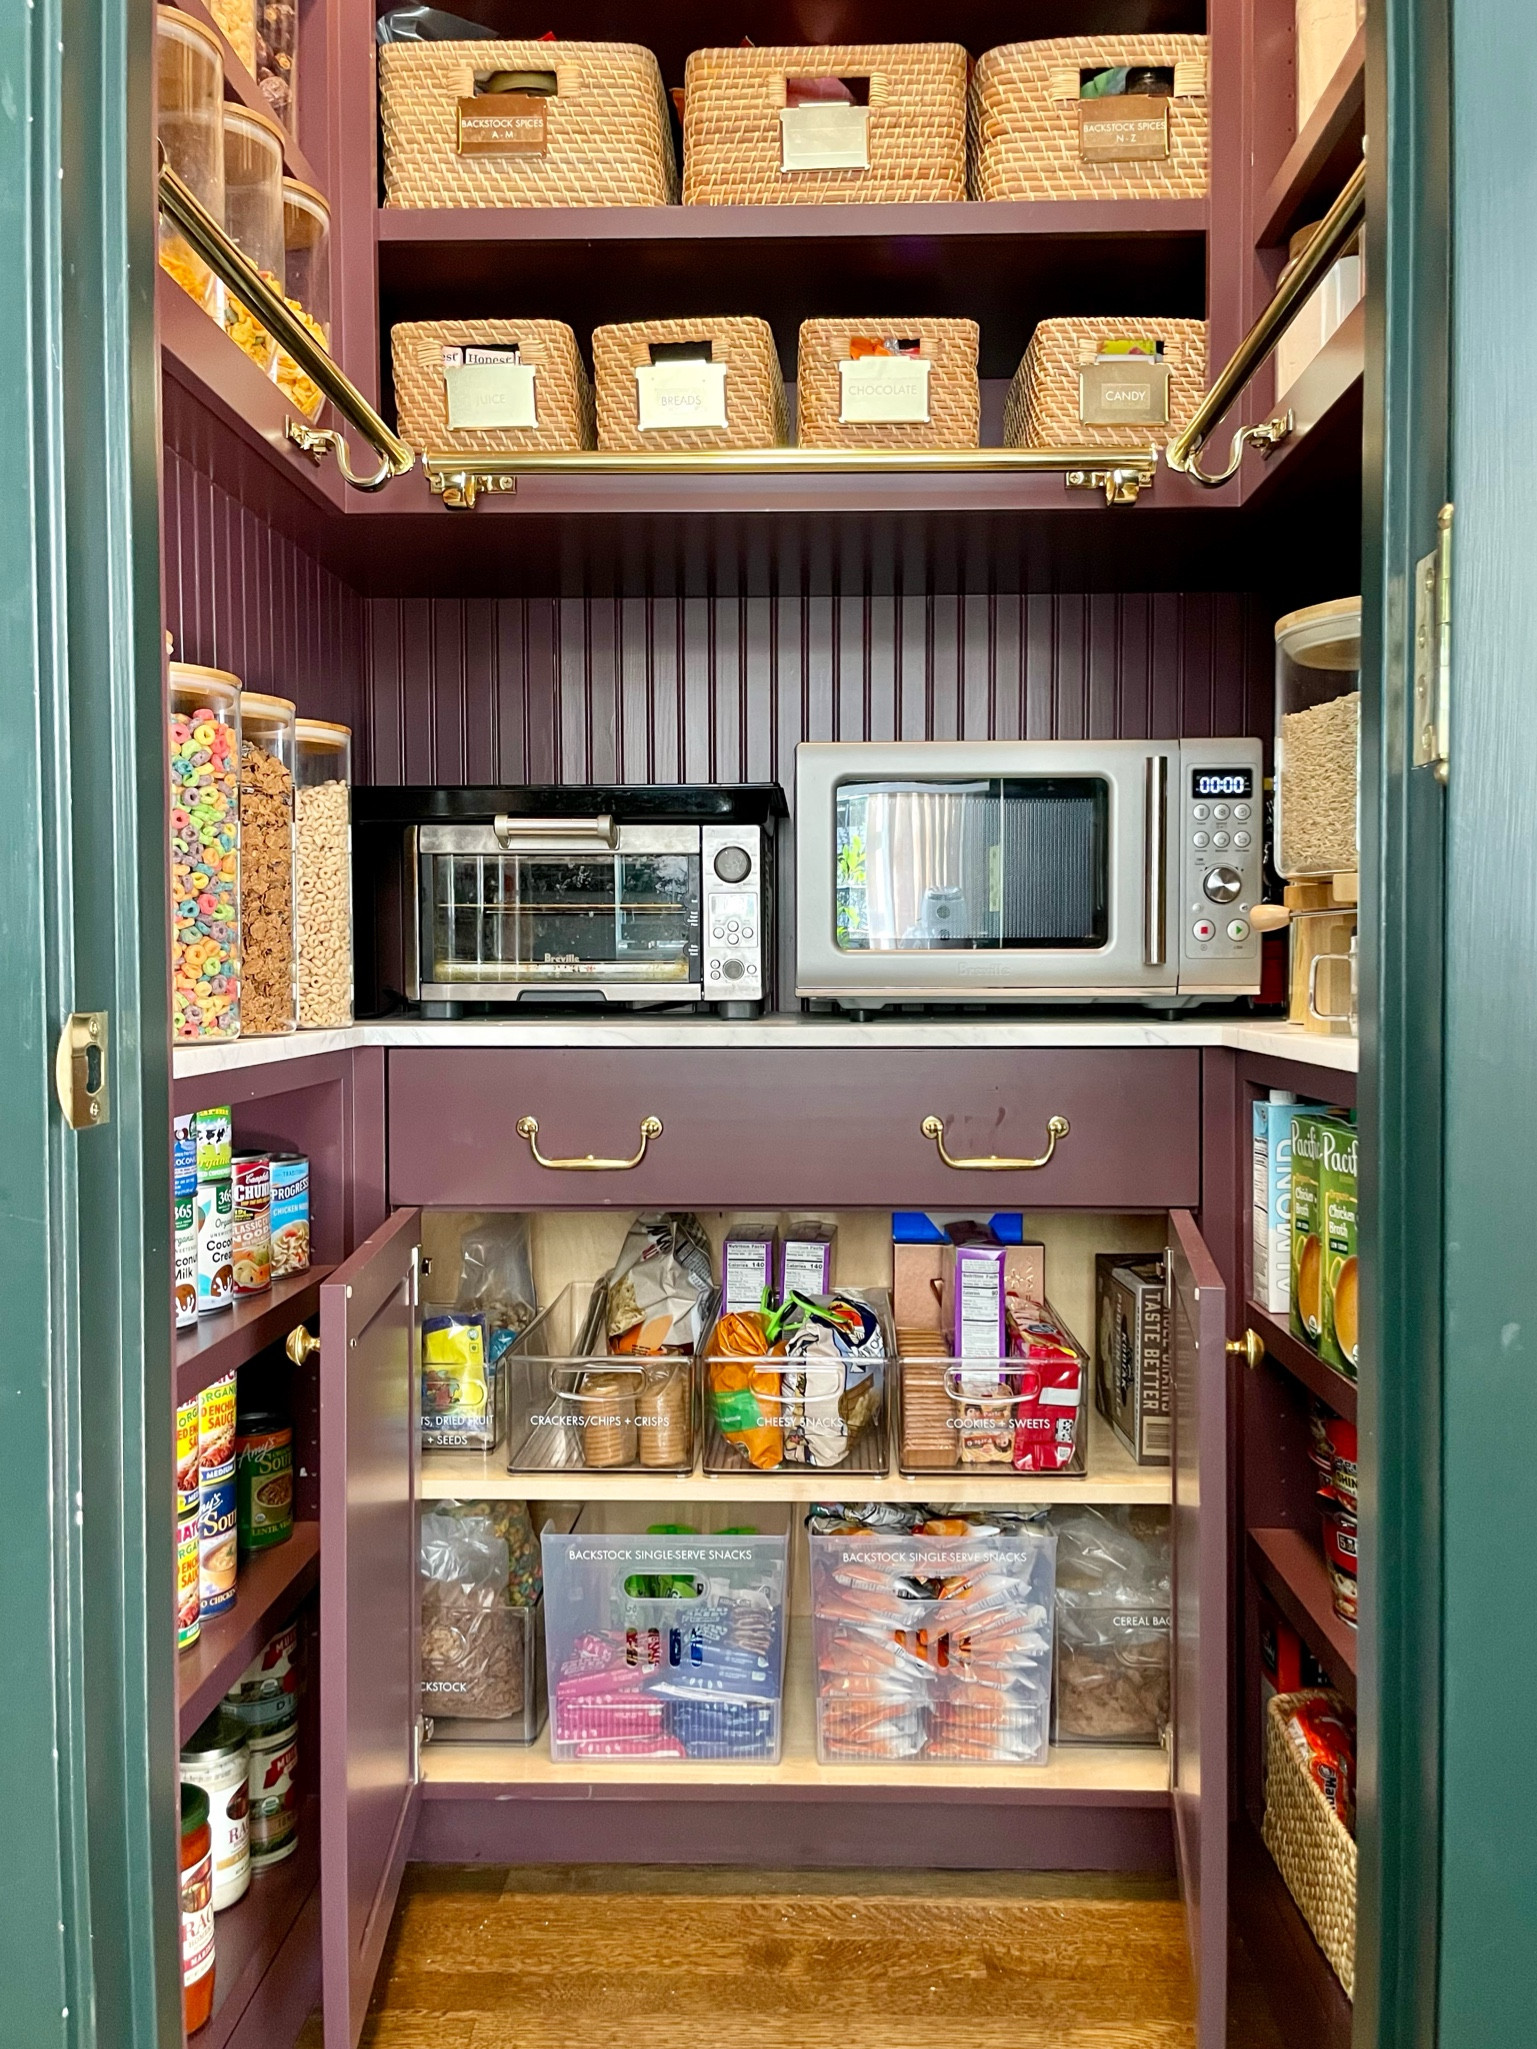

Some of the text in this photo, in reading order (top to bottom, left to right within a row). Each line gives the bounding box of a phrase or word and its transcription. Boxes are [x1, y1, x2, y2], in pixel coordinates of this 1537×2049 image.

[461, 119, 544, 128] BACKSTOCK SPICES
[1083, 121, 1166, 133] BACKSTOCK SPICES
[491, 130, 499, 139] A
[505, 130, 514, 139] M
[1116, 134, 1125, 143] N
[1130, 133, 1137, 143] Z
[848, 384, 918, 396] CHOCOLATE
[1105, 390, 1146, 401] CANDY
[661, 394, 702, 406] BREADS
[544, 952, 580, 963] Breville
[1291, 1120, 1321, 1160] Pacific
[272, 1205, 298, 1217] CHICKEN
[1328, 1204, 1356, 1222] Chicken
[1328, 1221, 1348, 1238] Broth
[1142, 1292, 1161, 1409] TASTE BETTER
[207, 1411, 235, 1430] SAUCE
[436, 1416, 465, 1426] DRIED
[468, 1415, 494, 1425] FRUIT
[530, 1415, 622, 1428] CRACKERS/CHIPS
[634, 1416, 670, 1427] CRISPS
[756, 1417, 845, 1428] CHEESY SNACKS
[945, 1418, 996, 1429] COOKIES
[1008, 1418, 1051, 1429] SWEETS
[436, 1435, 468, 1445] SEEDS
[237, 1436, 276, 1469] Amy's
[206, 1462, 235, 1480] MEDIUM
[1335, 1471, 1358, 1489] SHIN
[569, 1549, 752, 1561] BACKSTOCK SINGLE-SERVE SNACKS
[842, 1552, 1027, 1563] BACKSTOCK SINGLE-SERVE SNACKS
[1112, 1616, 1150, 1627] CEREAL
